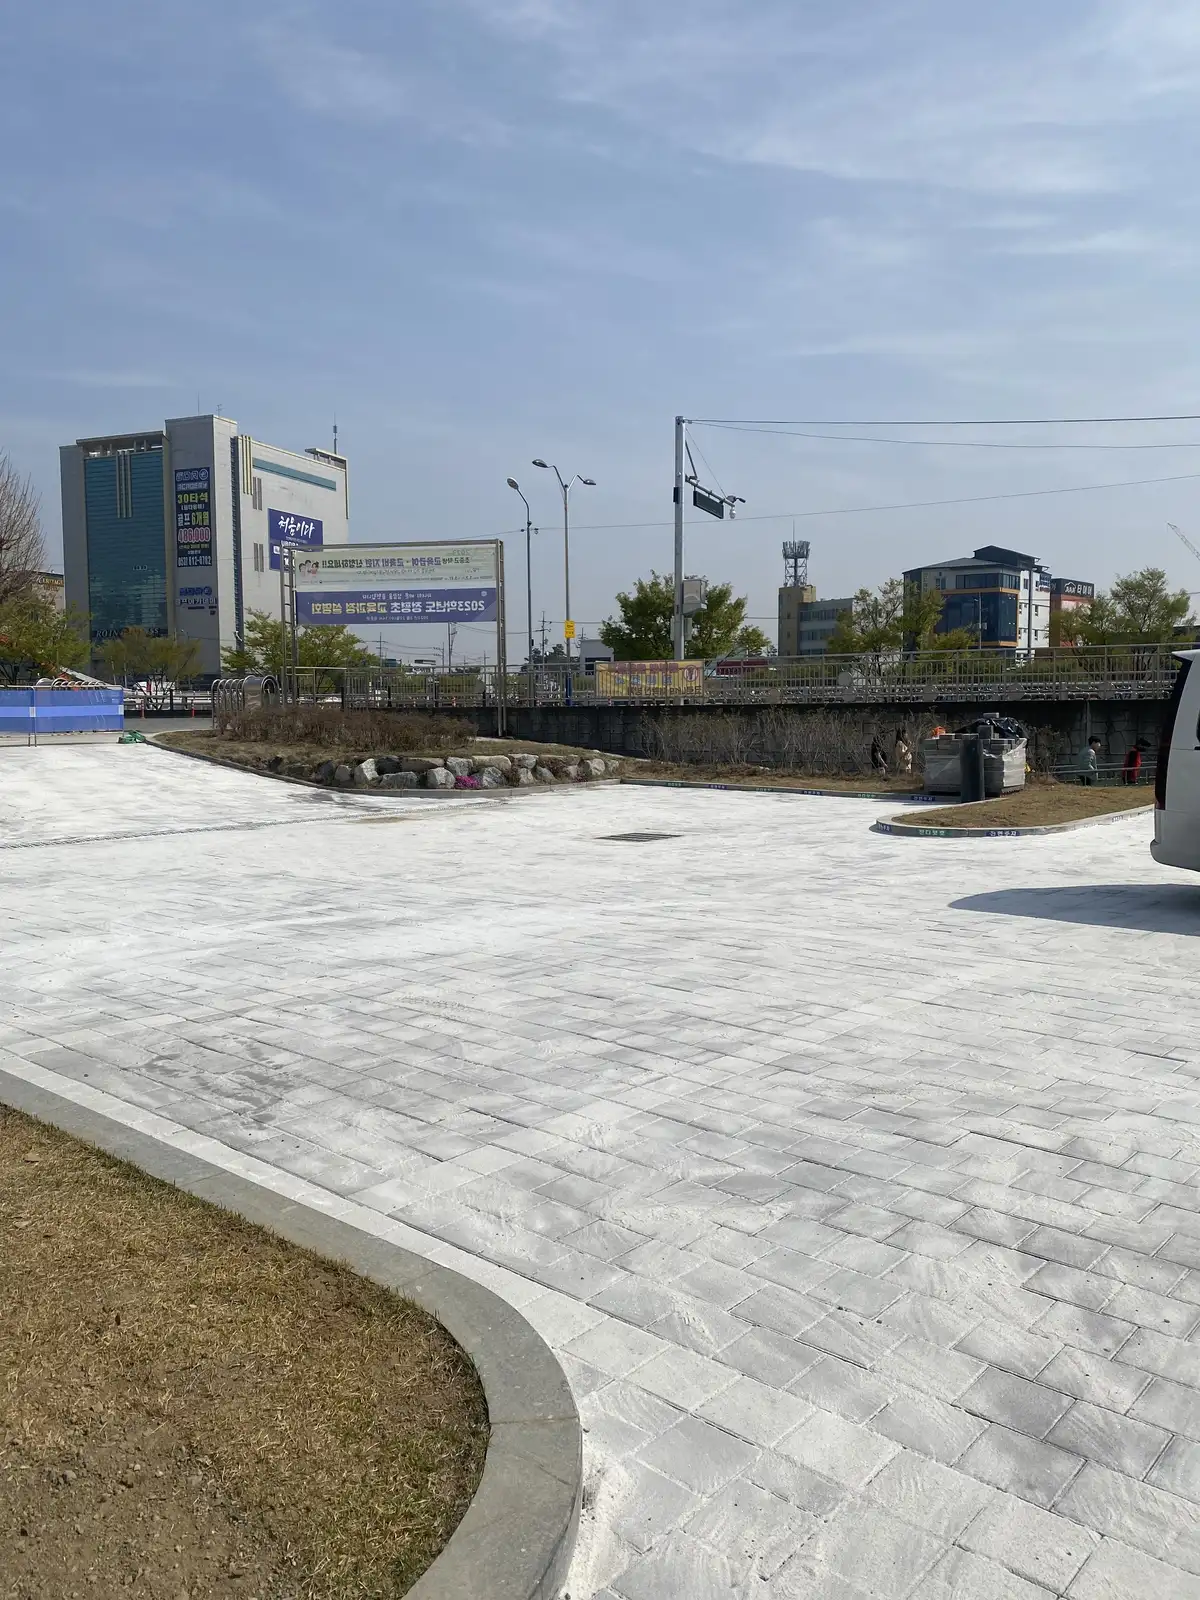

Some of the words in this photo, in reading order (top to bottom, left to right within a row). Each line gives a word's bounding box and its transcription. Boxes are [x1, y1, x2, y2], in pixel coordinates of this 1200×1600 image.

[177, 492, 208, 504] 30타석
[178, 526, 211, 543] 486,000
[278, 515, 315, 539] 처음이다
